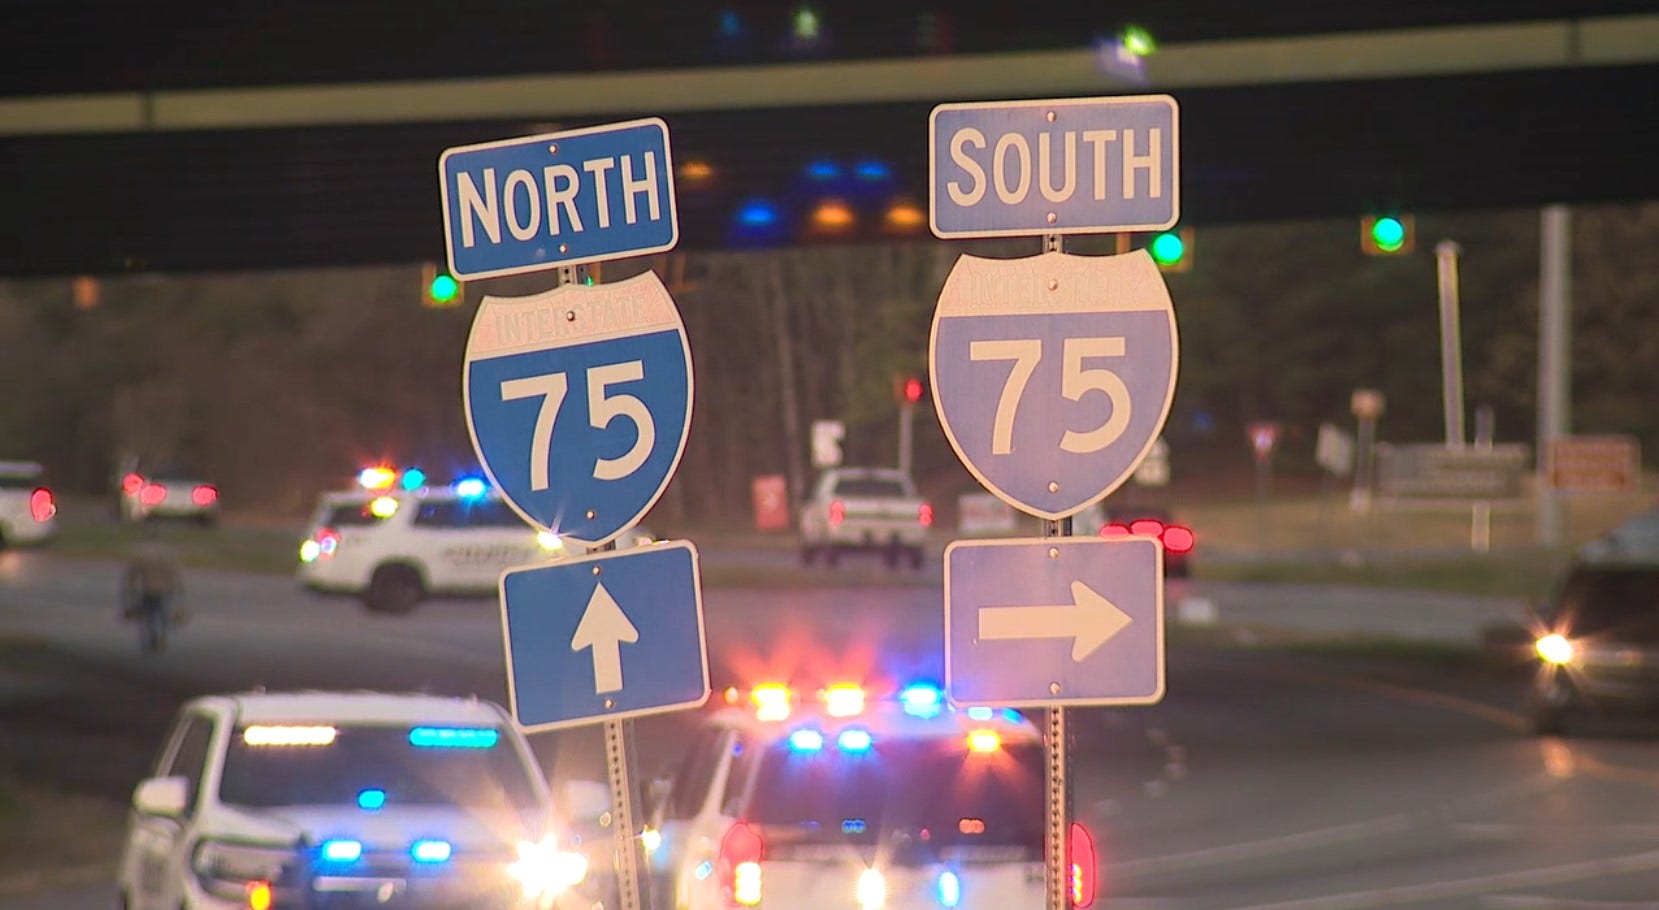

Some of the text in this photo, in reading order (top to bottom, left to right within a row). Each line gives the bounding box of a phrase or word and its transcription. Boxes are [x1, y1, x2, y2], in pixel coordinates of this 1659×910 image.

[456, 151, 661, 248] NORTH
[946, 127, 1162, 207] SOUTH
[496, 294, 650, 345] INTERSTATE
[500, 359, 656, 492] 75
[969, 336, 1132, 455] 75
